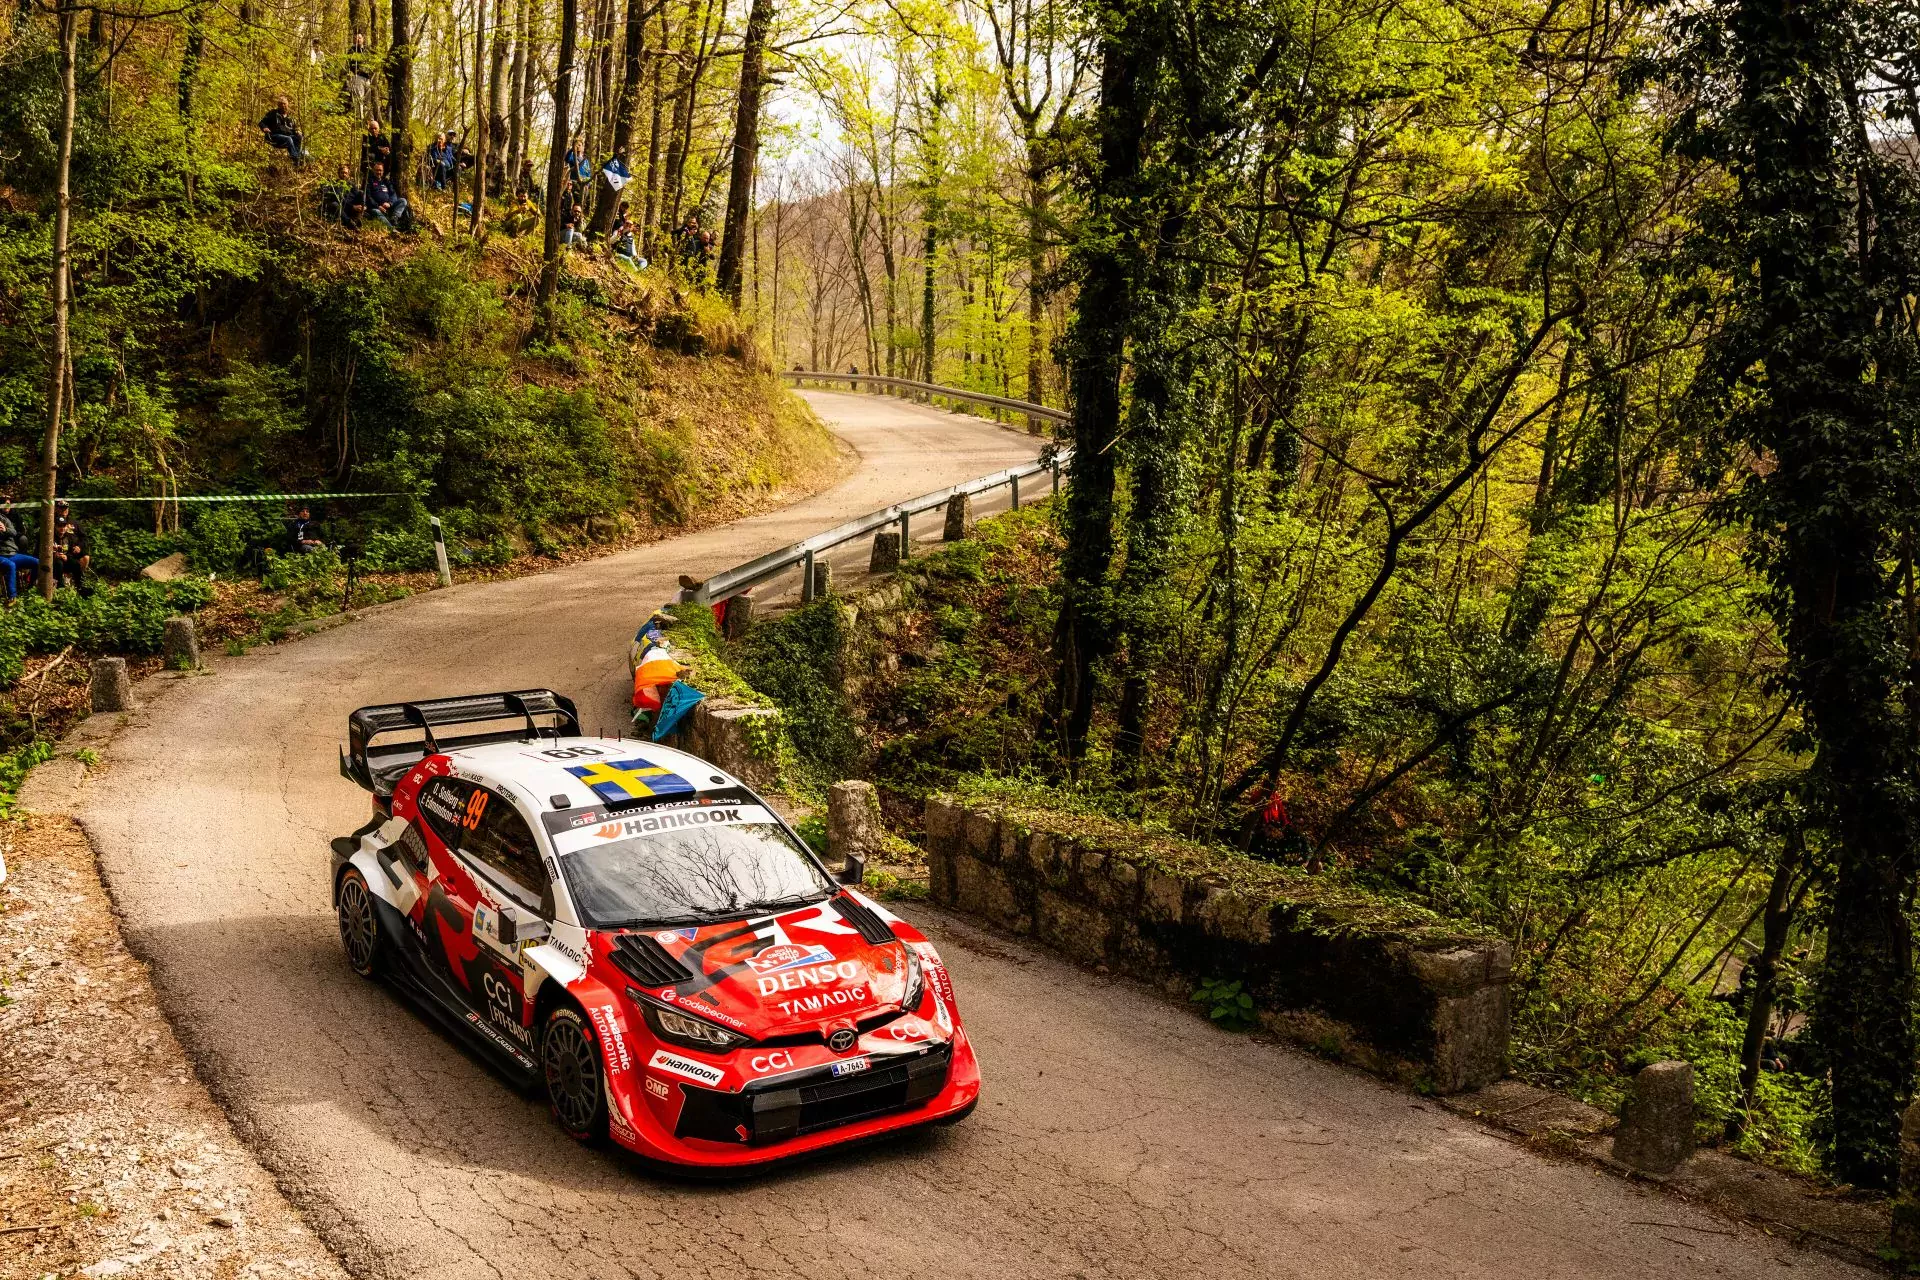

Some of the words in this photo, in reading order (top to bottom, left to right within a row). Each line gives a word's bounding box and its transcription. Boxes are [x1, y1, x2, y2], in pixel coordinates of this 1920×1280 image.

[425, 796, 453, 822] Edmondson
[439, 786, 459, 810] Solberg
[463, 789, 489, 831] 99
[572, 814, 597, 827] GR
[599, 805, 651, 820] TOYOTA
[549, 935, 582, 963] TAMADIC
[756, 961, 858, 997] DENSO
[678, 996, 746, 1028] codebeamer
[777, 987, 866, 1016] TAMADIC
[466, 1012, 480, 1022] GR
[476, 1019, 497, 1039] TOYOTA
[601, 1004, 631, 1071] Panasonic
[588, 1006, 621, 1076] AUTOMOTIVE
[840, 1062, 865, 1074] A-7645
[645, 1078, 670, 1097] OMP
